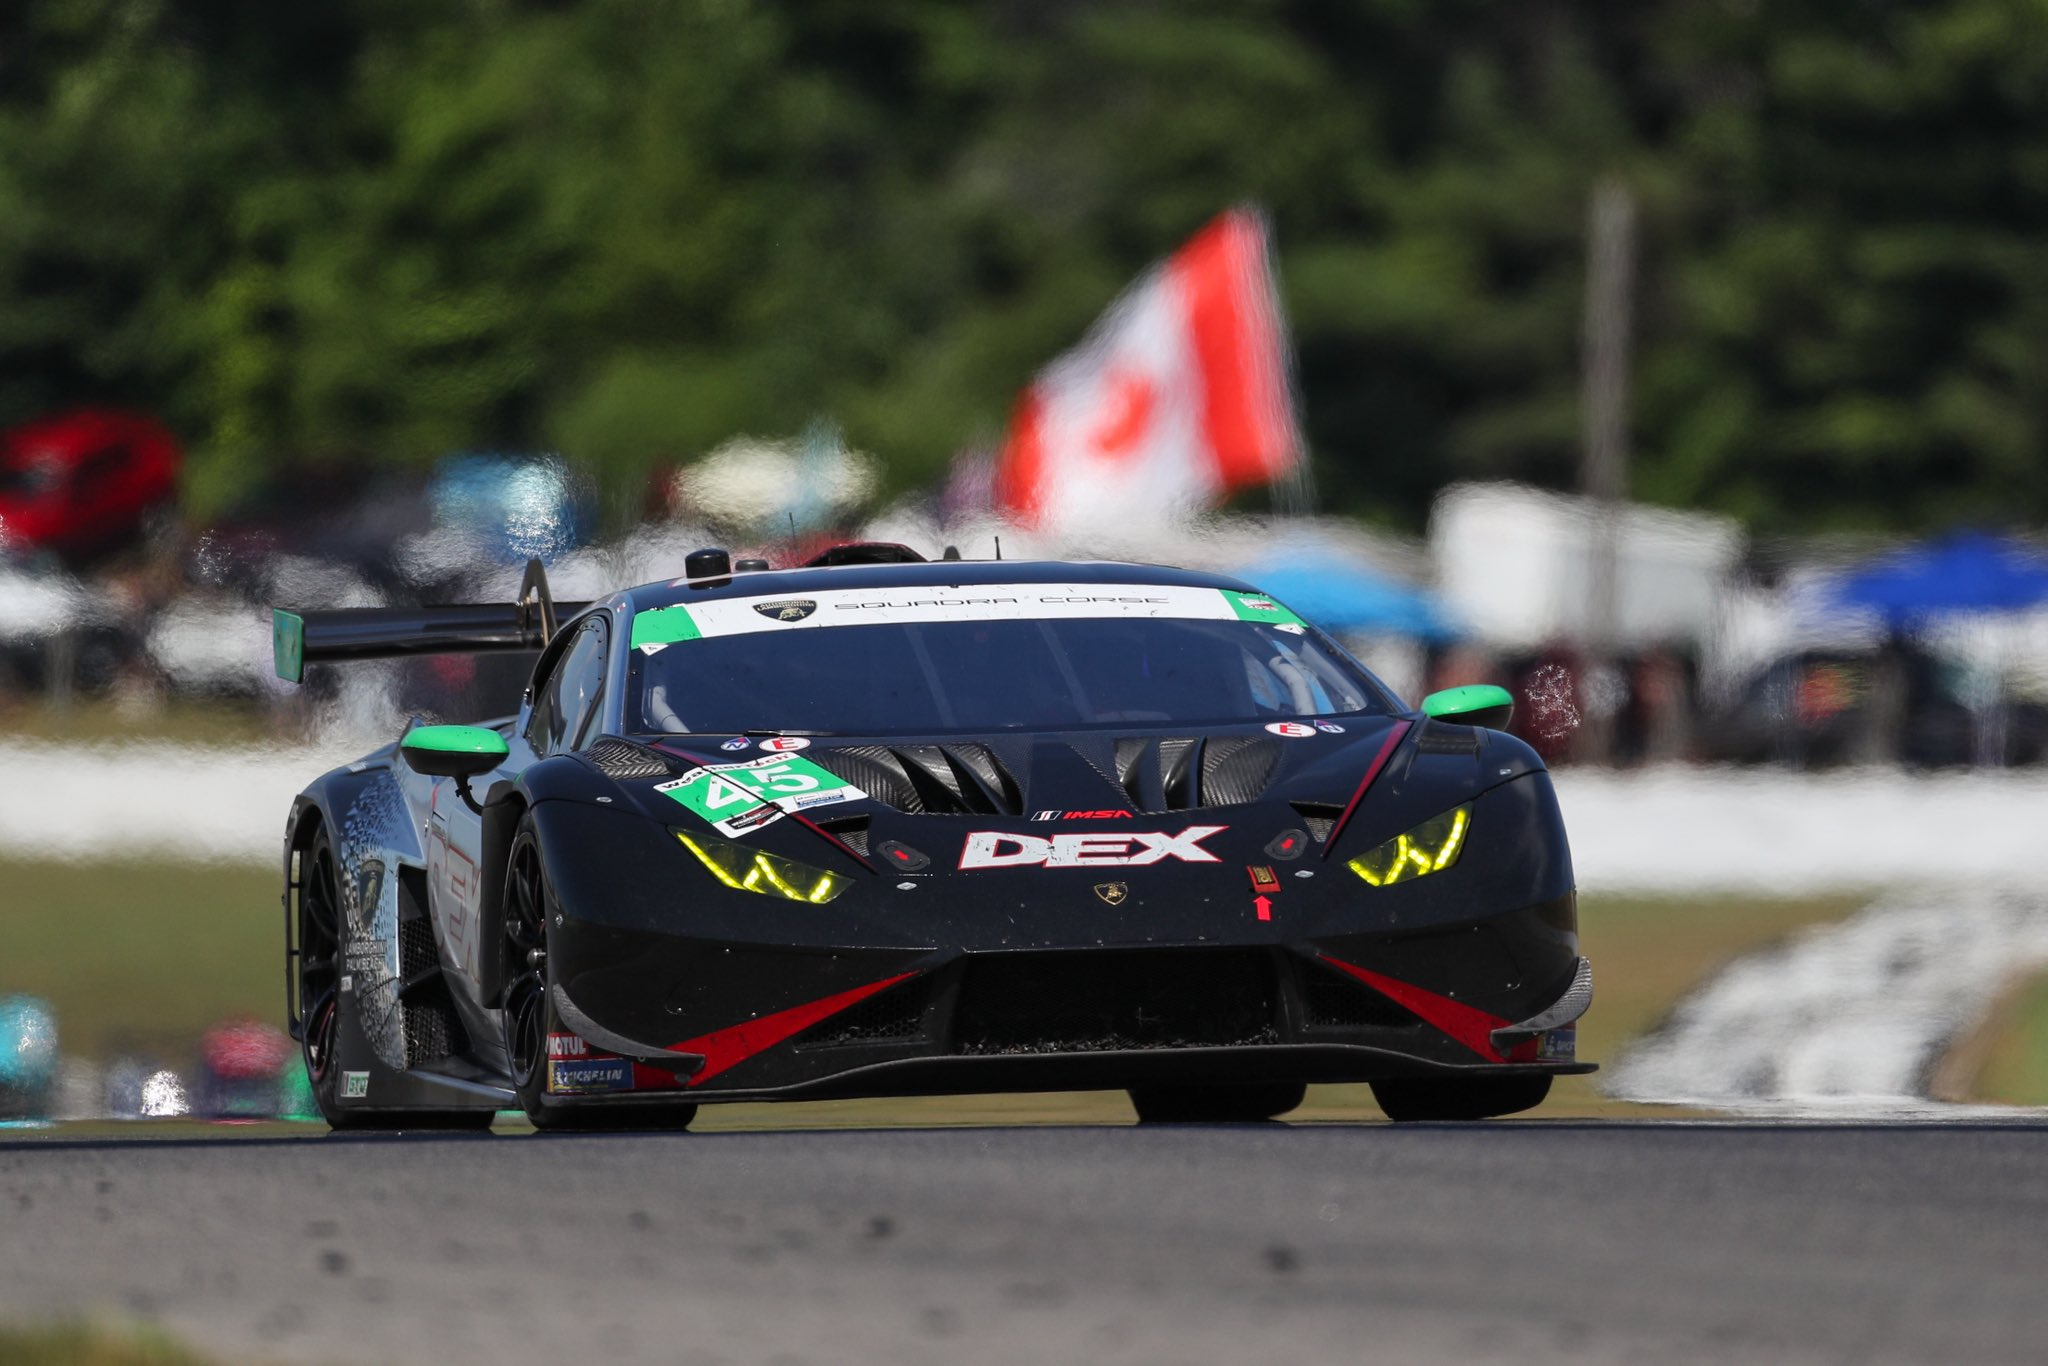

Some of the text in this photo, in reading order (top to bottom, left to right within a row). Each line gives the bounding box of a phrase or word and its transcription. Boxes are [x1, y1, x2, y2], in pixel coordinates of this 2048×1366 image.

[834, 596, 1169, 610] SQUADRA CORSE
[771, 737, 799, 750] E
[662, 753, 790, 789] weahertech
[705, 764, 819, 810] 45
[1063, 809, 1134, 820] IMSA
[957, 825, 1231, 870] DEX
[548, 1036, 586, 1056] MOTUL
